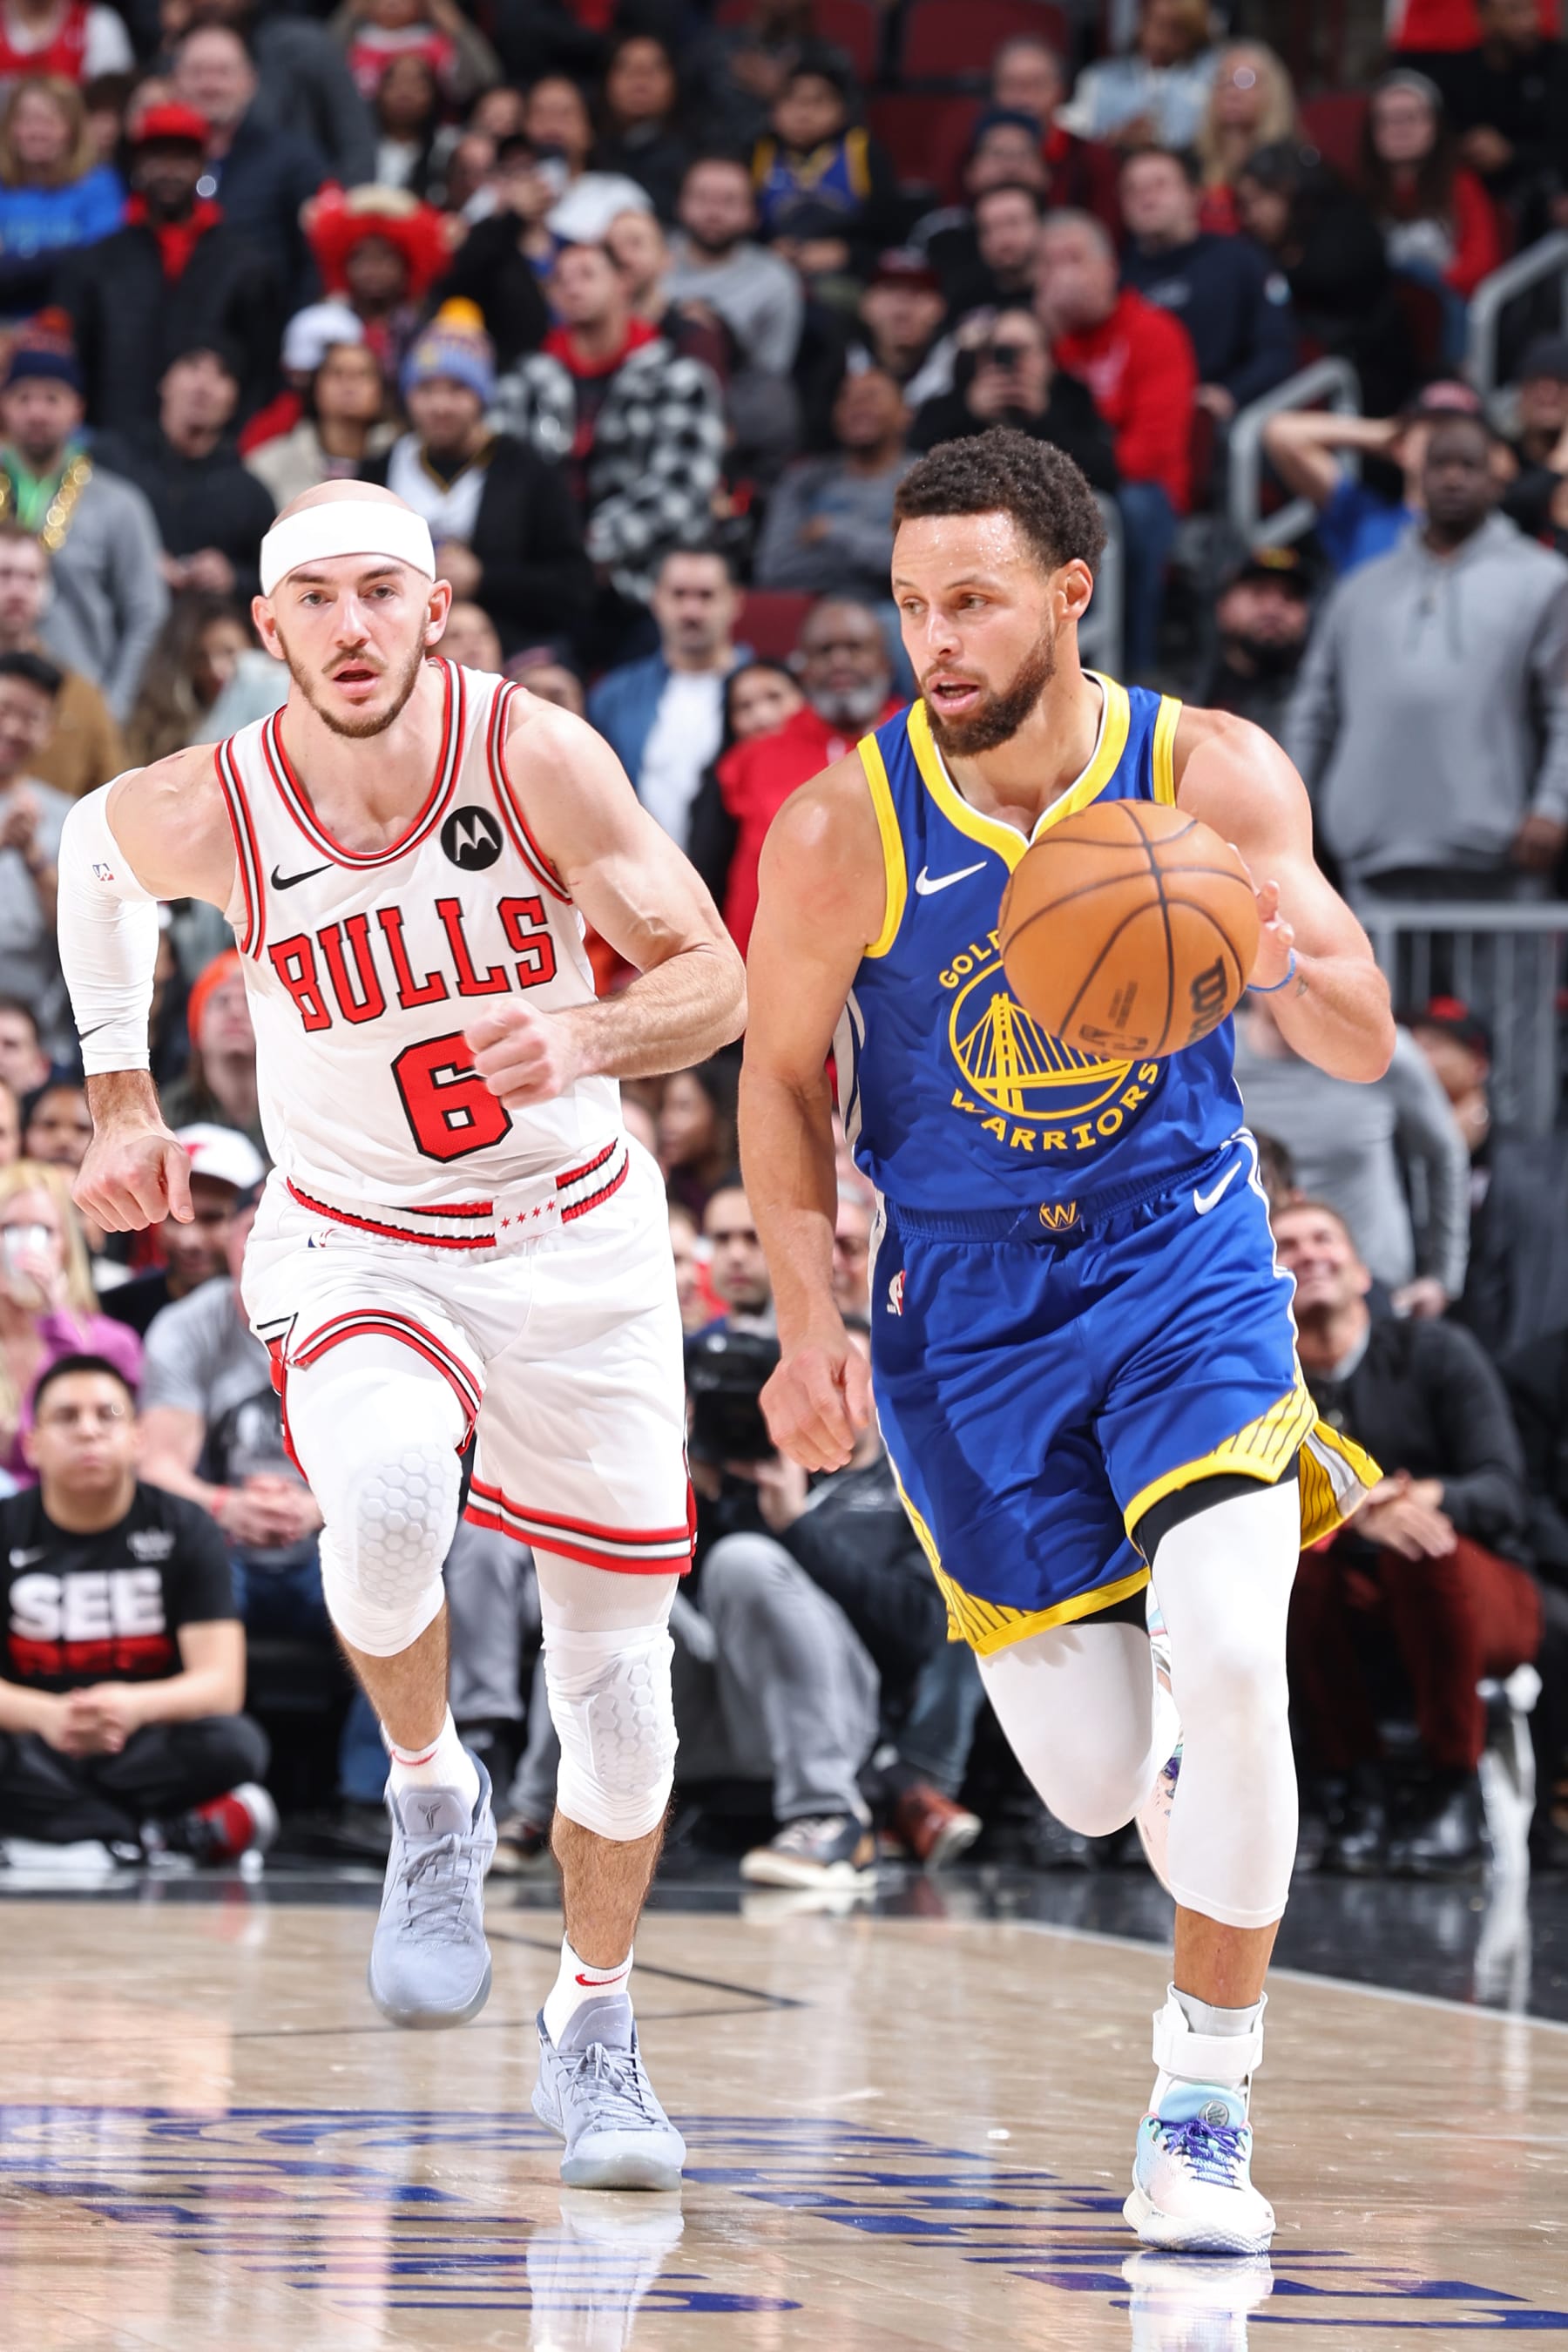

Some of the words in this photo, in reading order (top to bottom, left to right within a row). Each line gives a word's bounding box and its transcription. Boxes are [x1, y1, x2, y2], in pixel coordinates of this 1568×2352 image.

[267, 895, 558, 1033] BULLS
[390, 1030, 514, 1164] 6
[950, 1063, 1159, 1152] WARRIORS
[1040, 1200, 1077, 1228] W
[9, 1568, 166, 1643] SEE
